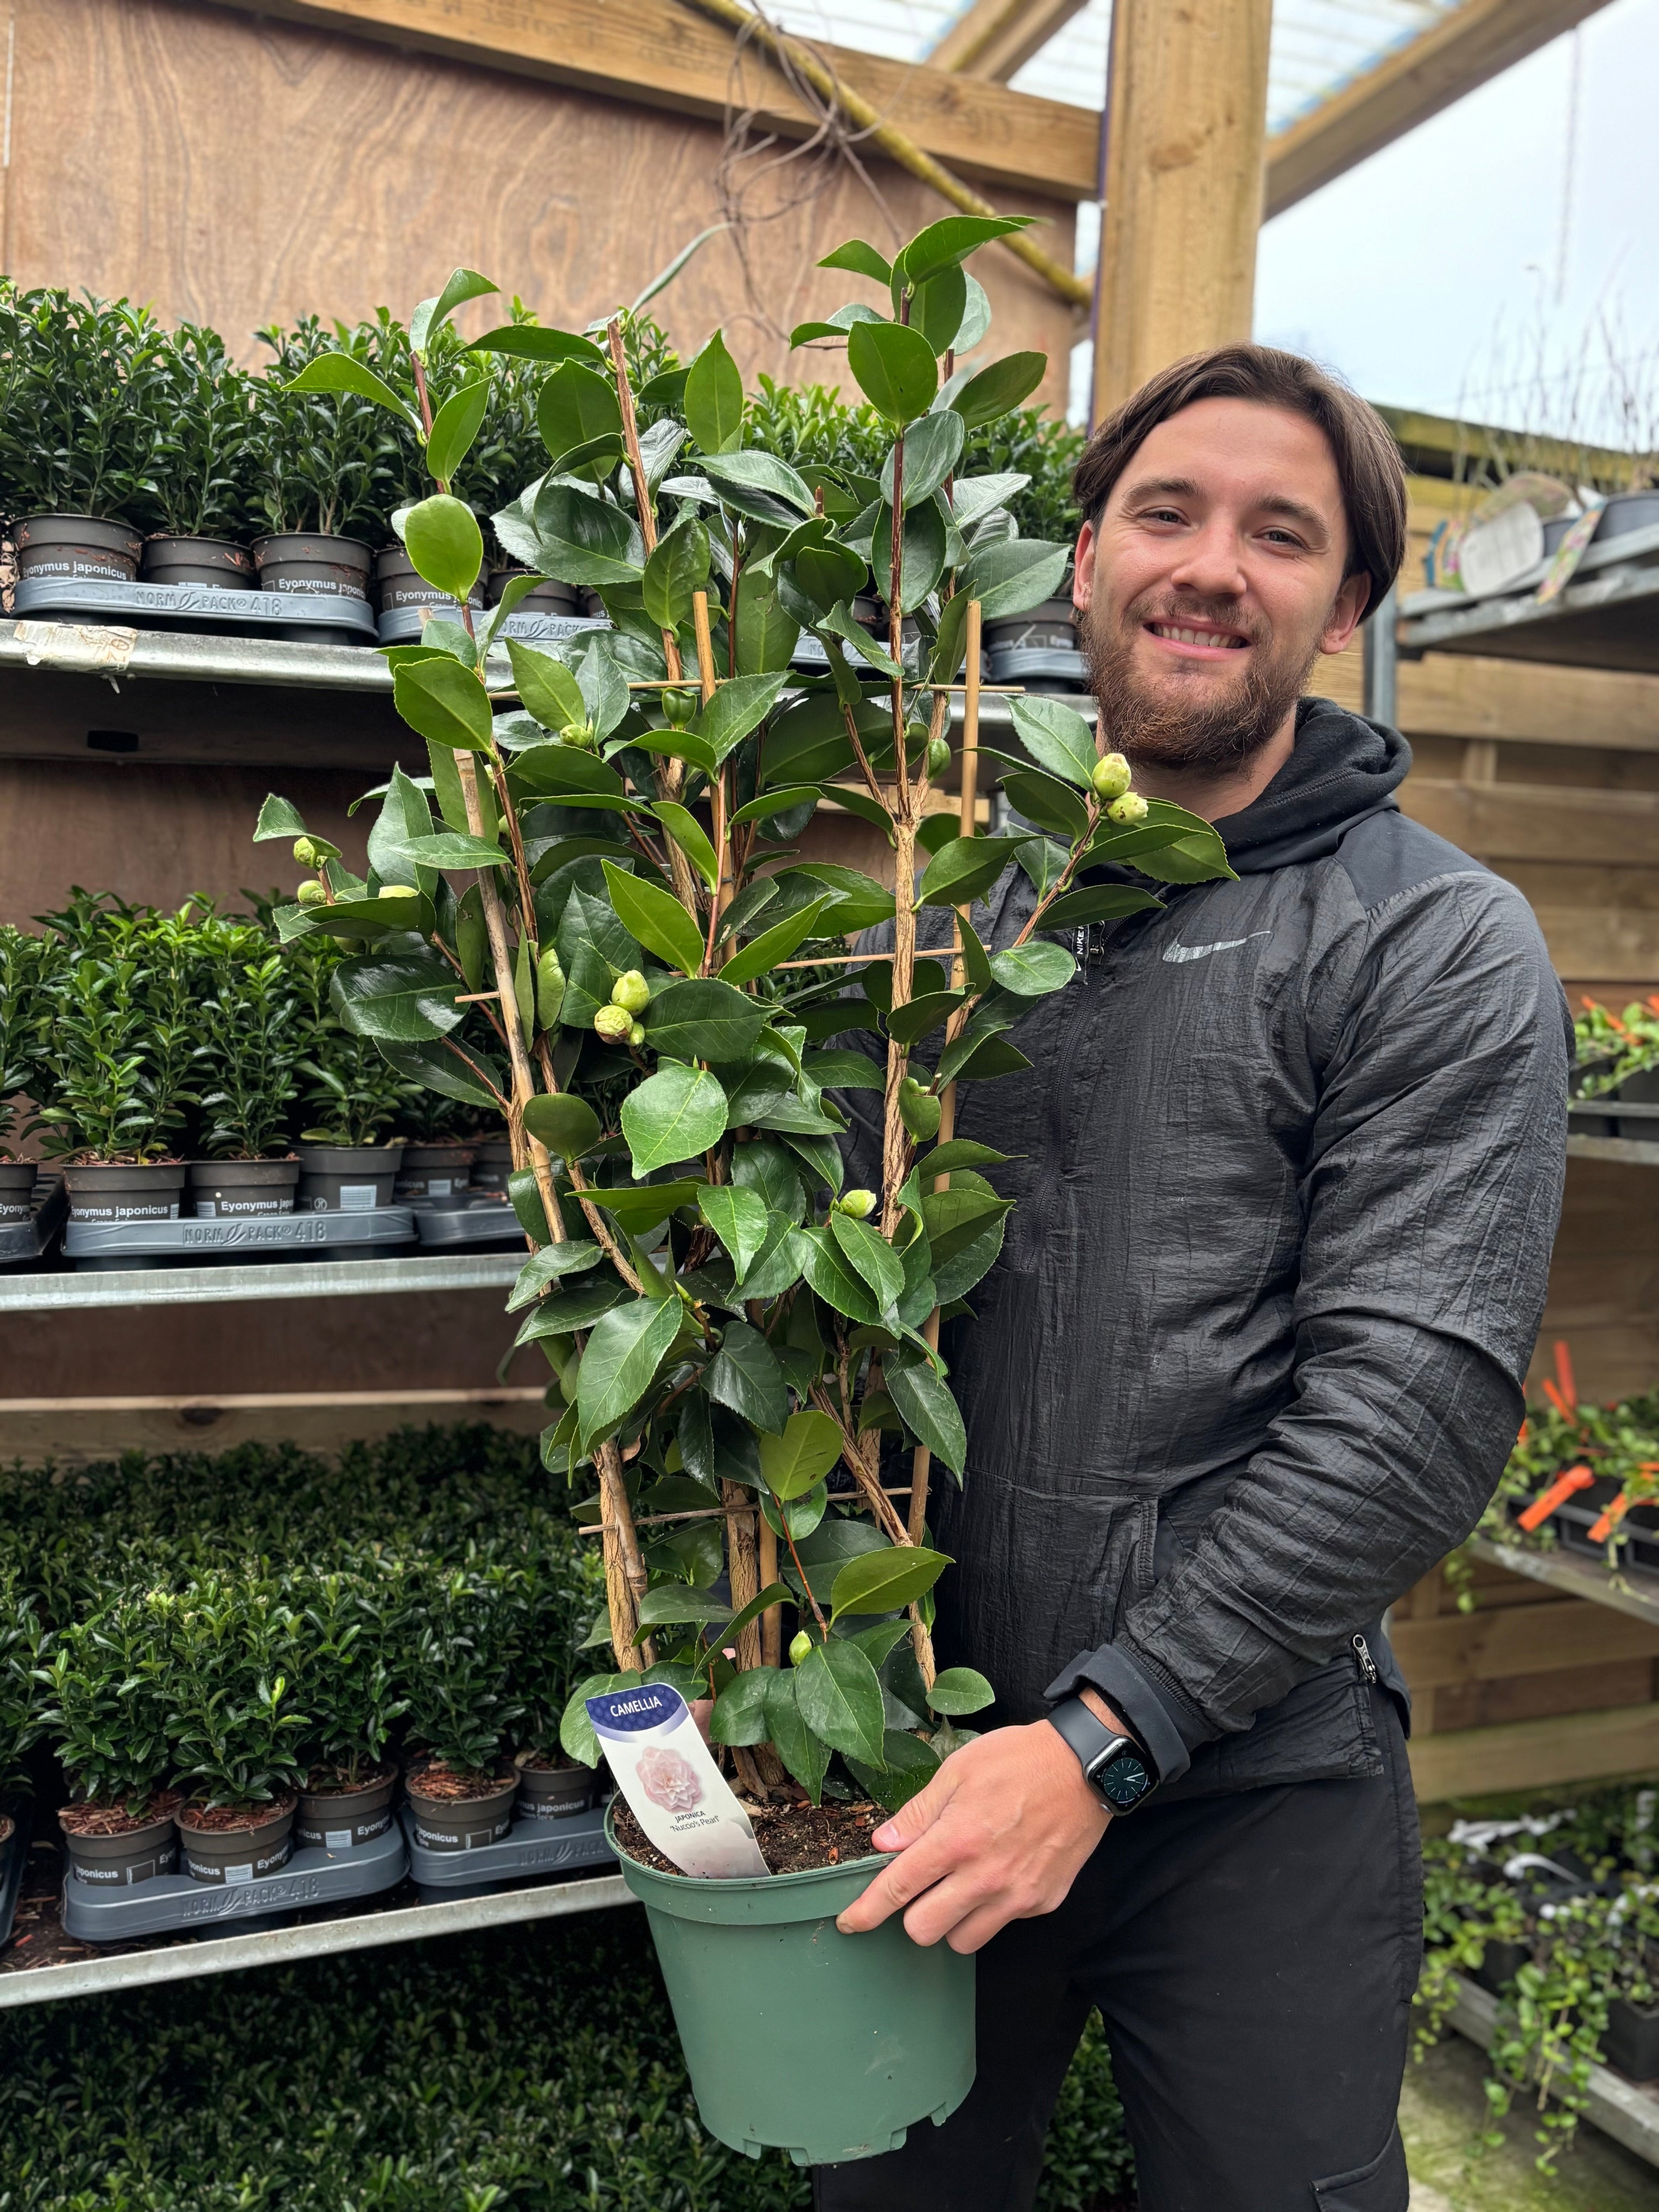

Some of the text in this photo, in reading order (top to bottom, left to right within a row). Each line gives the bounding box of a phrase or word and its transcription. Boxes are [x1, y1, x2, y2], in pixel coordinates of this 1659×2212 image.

[73, 561, 127, 580] japonicus
[279, 578, 336, 590] Eyonymus
[396, 591, 451, 601] Eyonymus
[115, 1205, 168, 1218] japonicus
[221, 1201, 278, 1213] Eyonymus
[185, 1228, 224, 1244] NORM
[295, 1220, 327, 1242] 418
[610, 1696, 662, 1717] CAMELLIA
[537, 1800, 585, 1813] japonicus
[675, 1811, 706, 1823] JAPONICA
